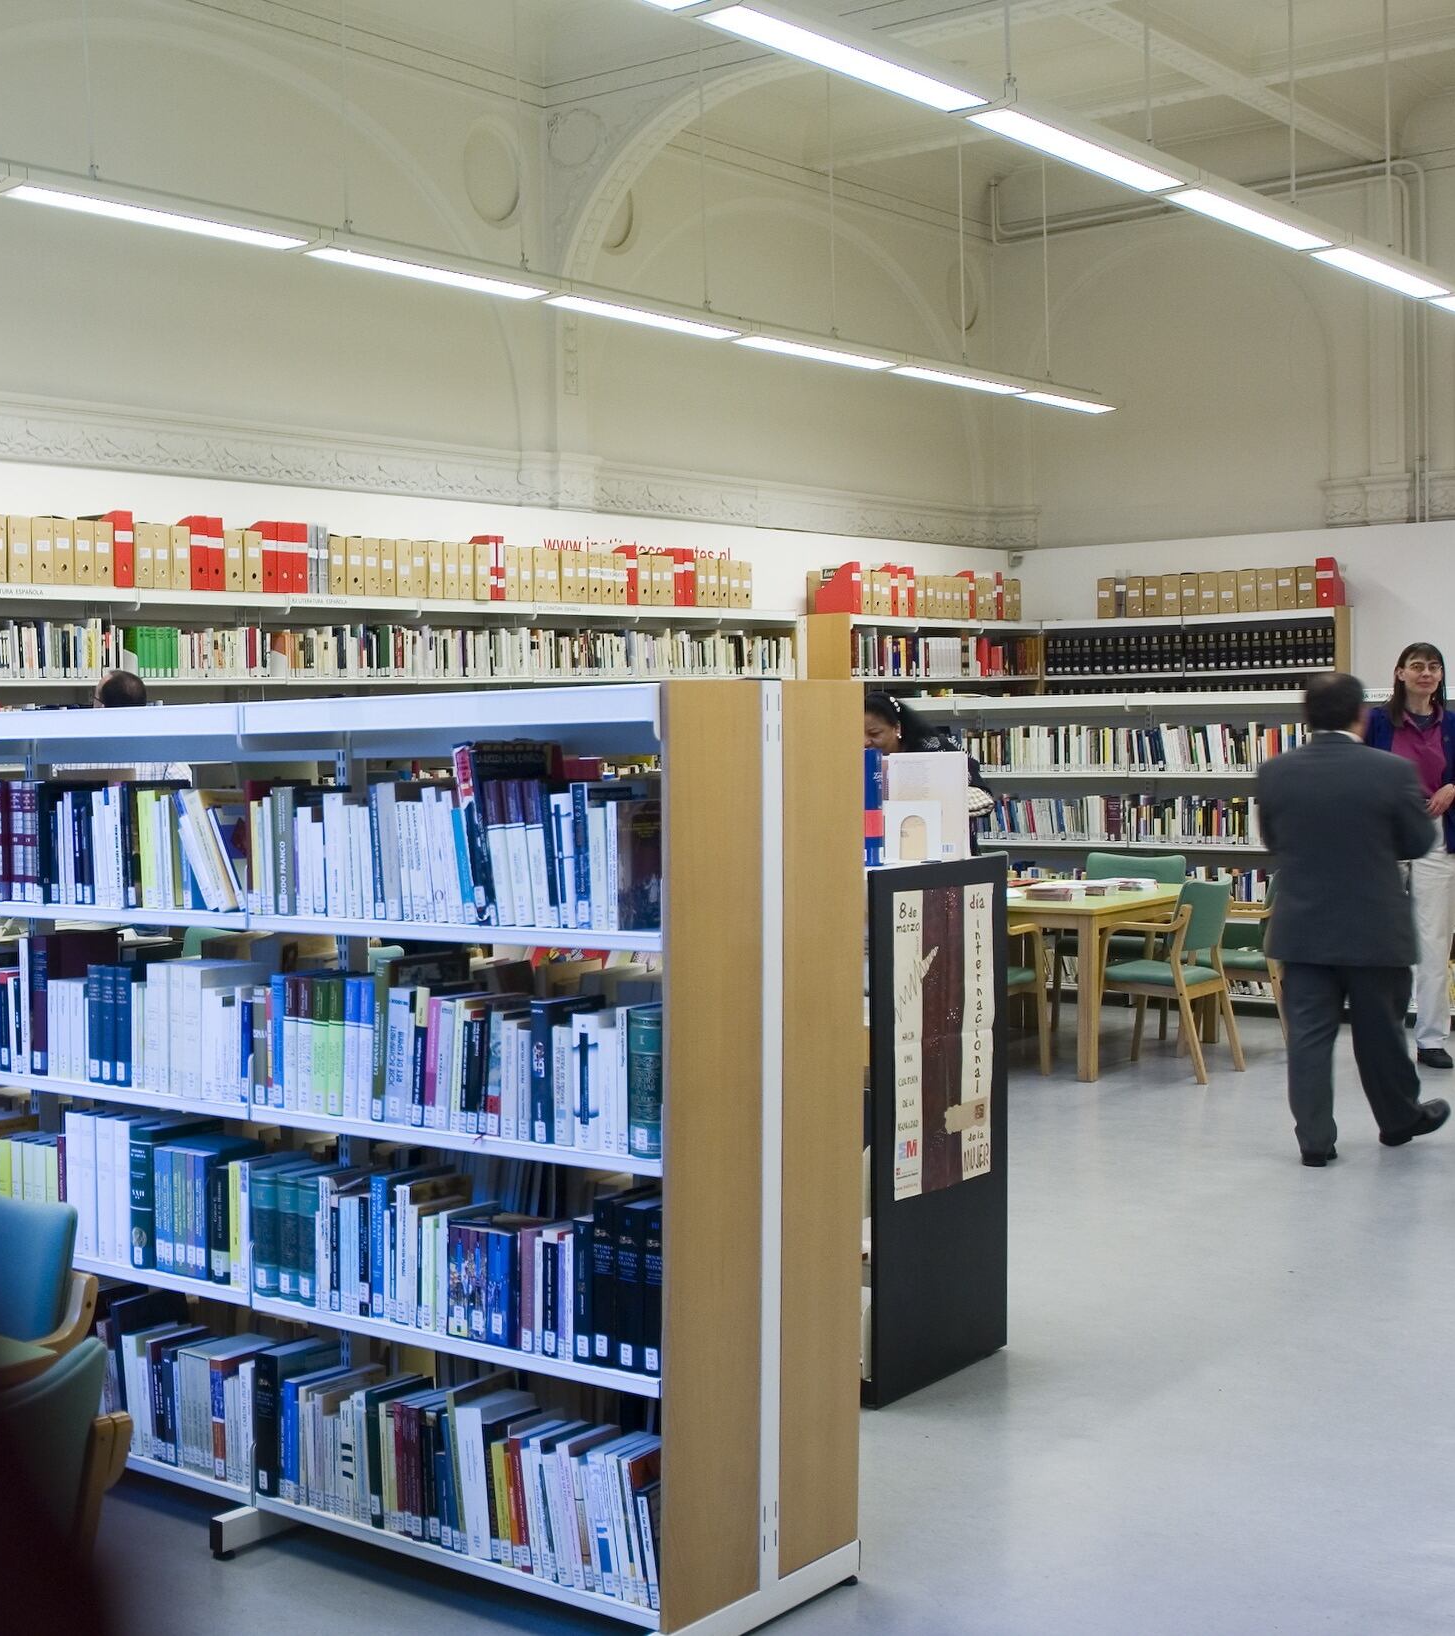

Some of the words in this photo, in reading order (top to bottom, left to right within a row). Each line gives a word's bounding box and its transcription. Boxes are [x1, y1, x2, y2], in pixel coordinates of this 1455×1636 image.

[16, 588, 44, 596] ESPAÑOLA
[279, 841, 287, 873] FRANCO
[969, 892, 985, 909] día
[899, 902, 907, 919] 8
[908, 907, 917, 918] de
[896, 922, 921, 933] marzo
[977, 1131, 984, 1139] la
[963, 1143, 989, 1173] MUJER
